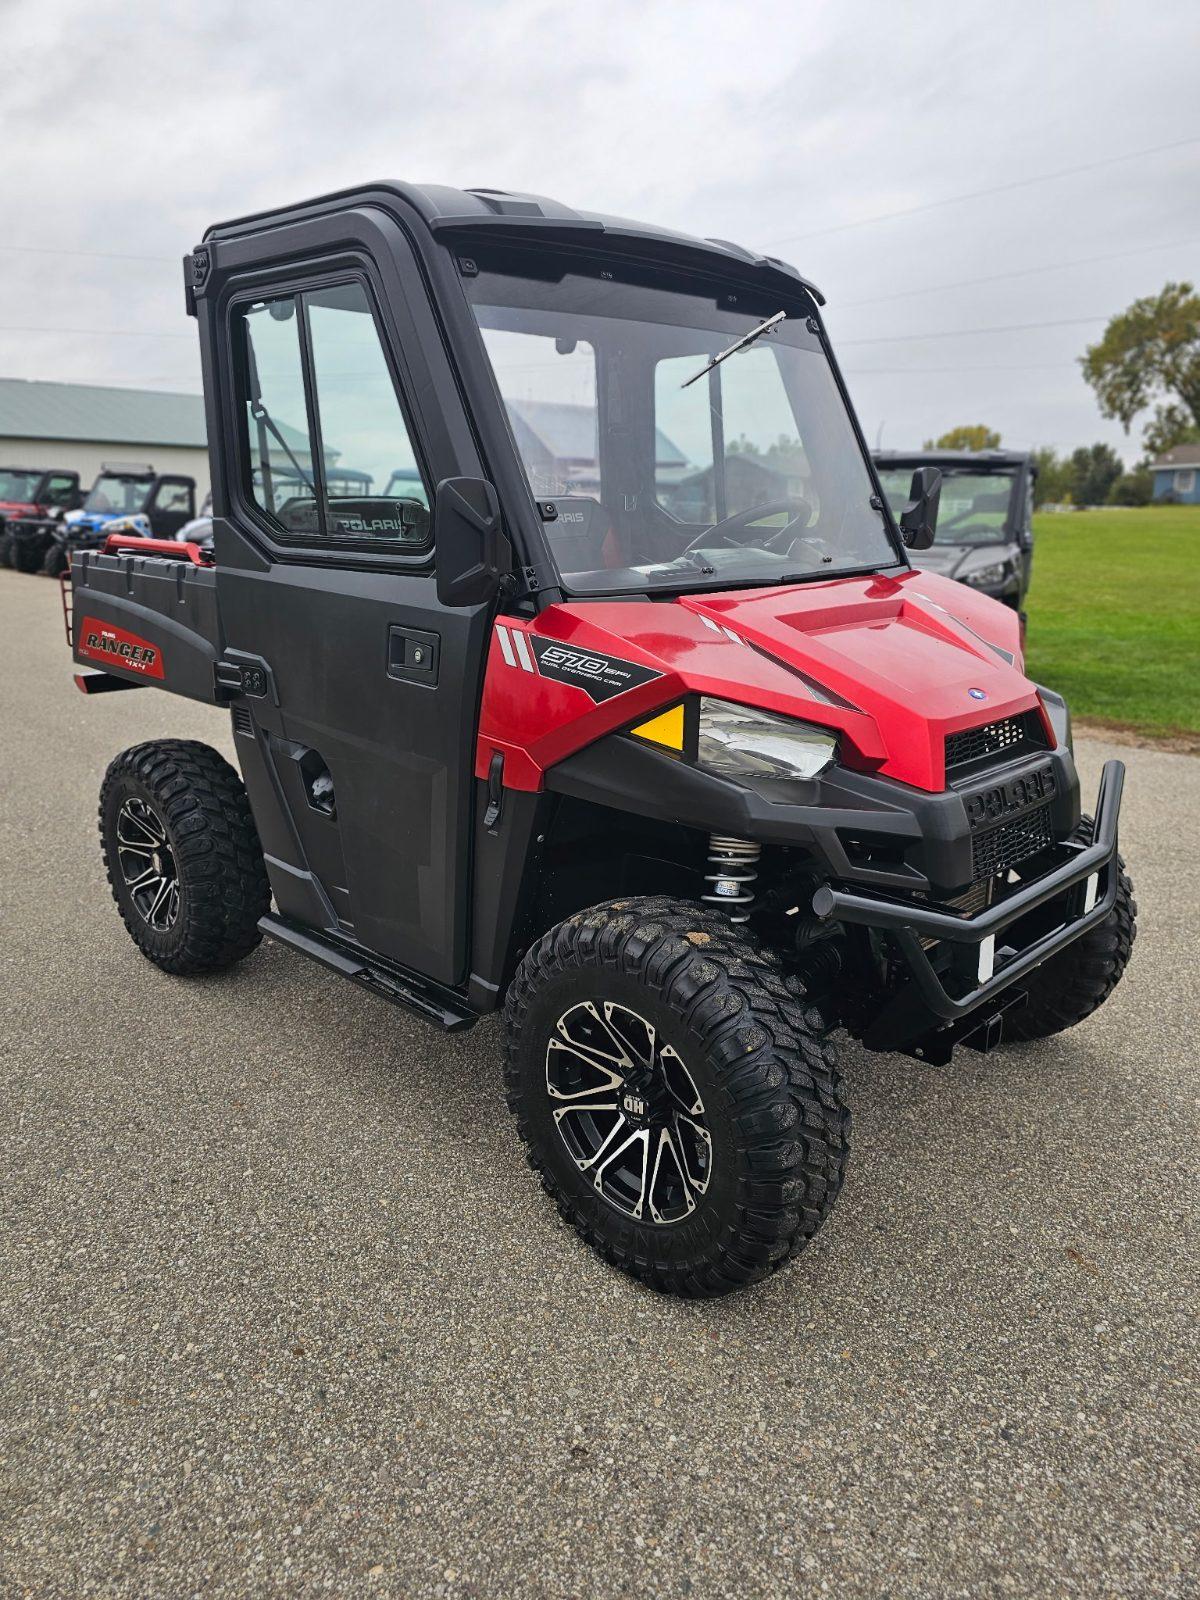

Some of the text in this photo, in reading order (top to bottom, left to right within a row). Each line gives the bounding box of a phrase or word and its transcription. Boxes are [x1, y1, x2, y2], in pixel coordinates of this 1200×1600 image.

[86, 633, 156, 664] RANGER
[540, 646, 608, 674] 570
[540, 660, 622, 687] DUAL OVERHEAD CAM
[965, 766, 1056, 829] POLARIS
[623, 1097, 644, 1115] HD
